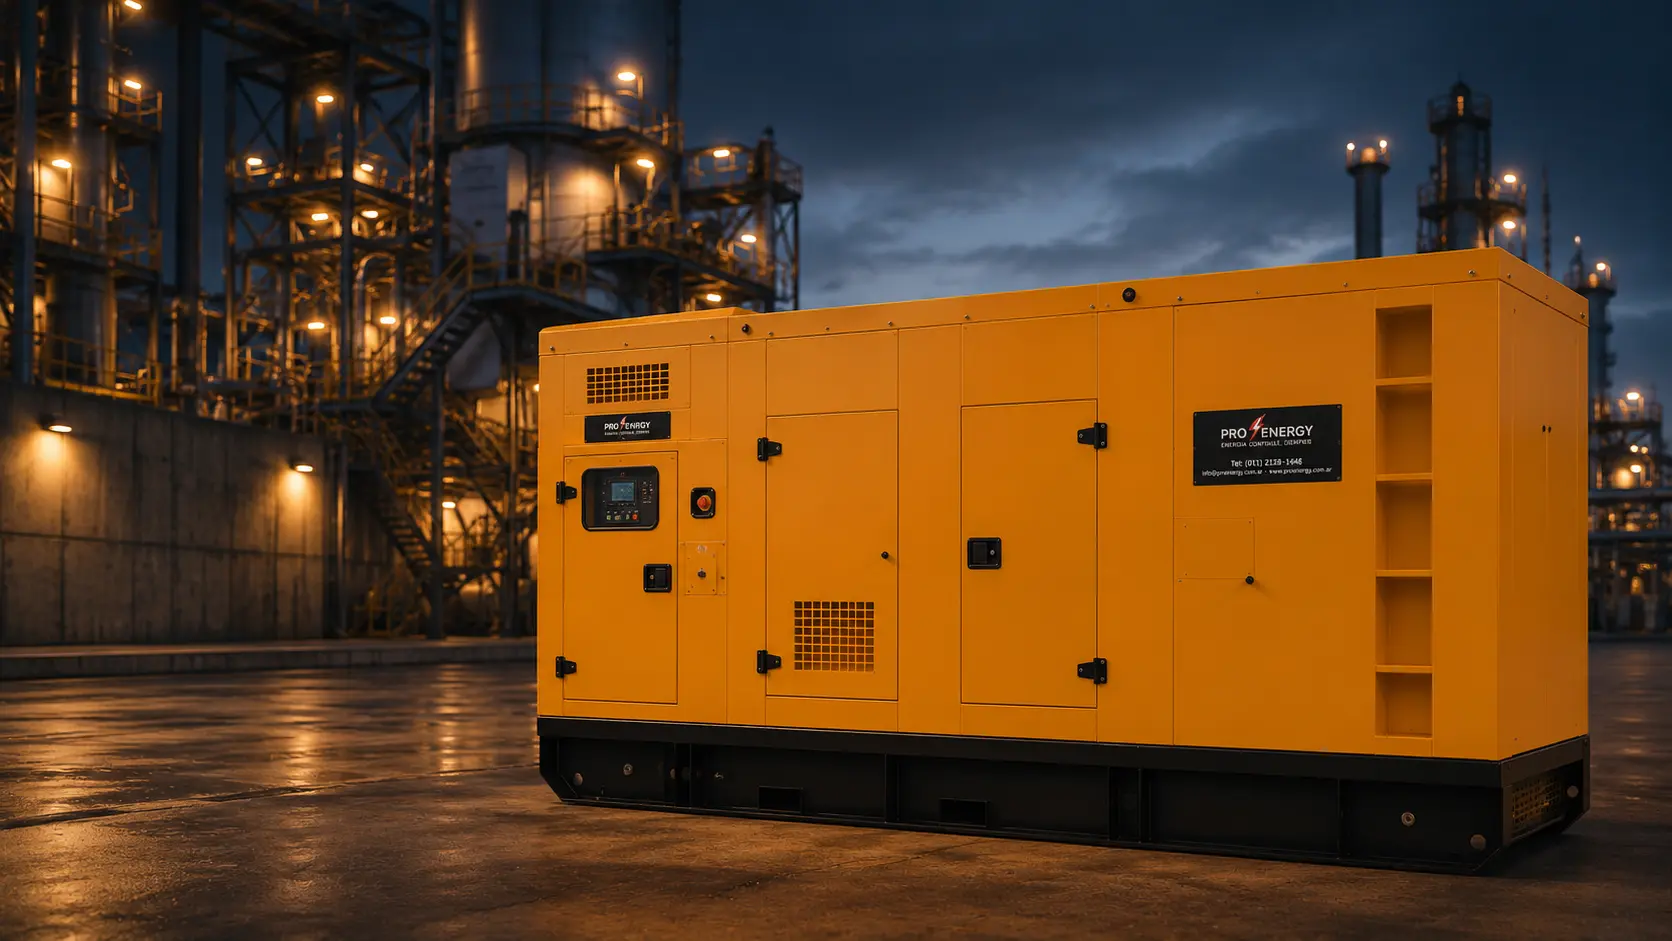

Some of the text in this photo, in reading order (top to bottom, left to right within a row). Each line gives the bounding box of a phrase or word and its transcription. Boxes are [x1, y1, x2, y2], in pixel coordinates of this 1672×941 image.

[604, 422, 619, 431] PRO
[1221, 425, 1314, 440] PRO ENERGY
[1244, 459, 1263, 468] (011)
